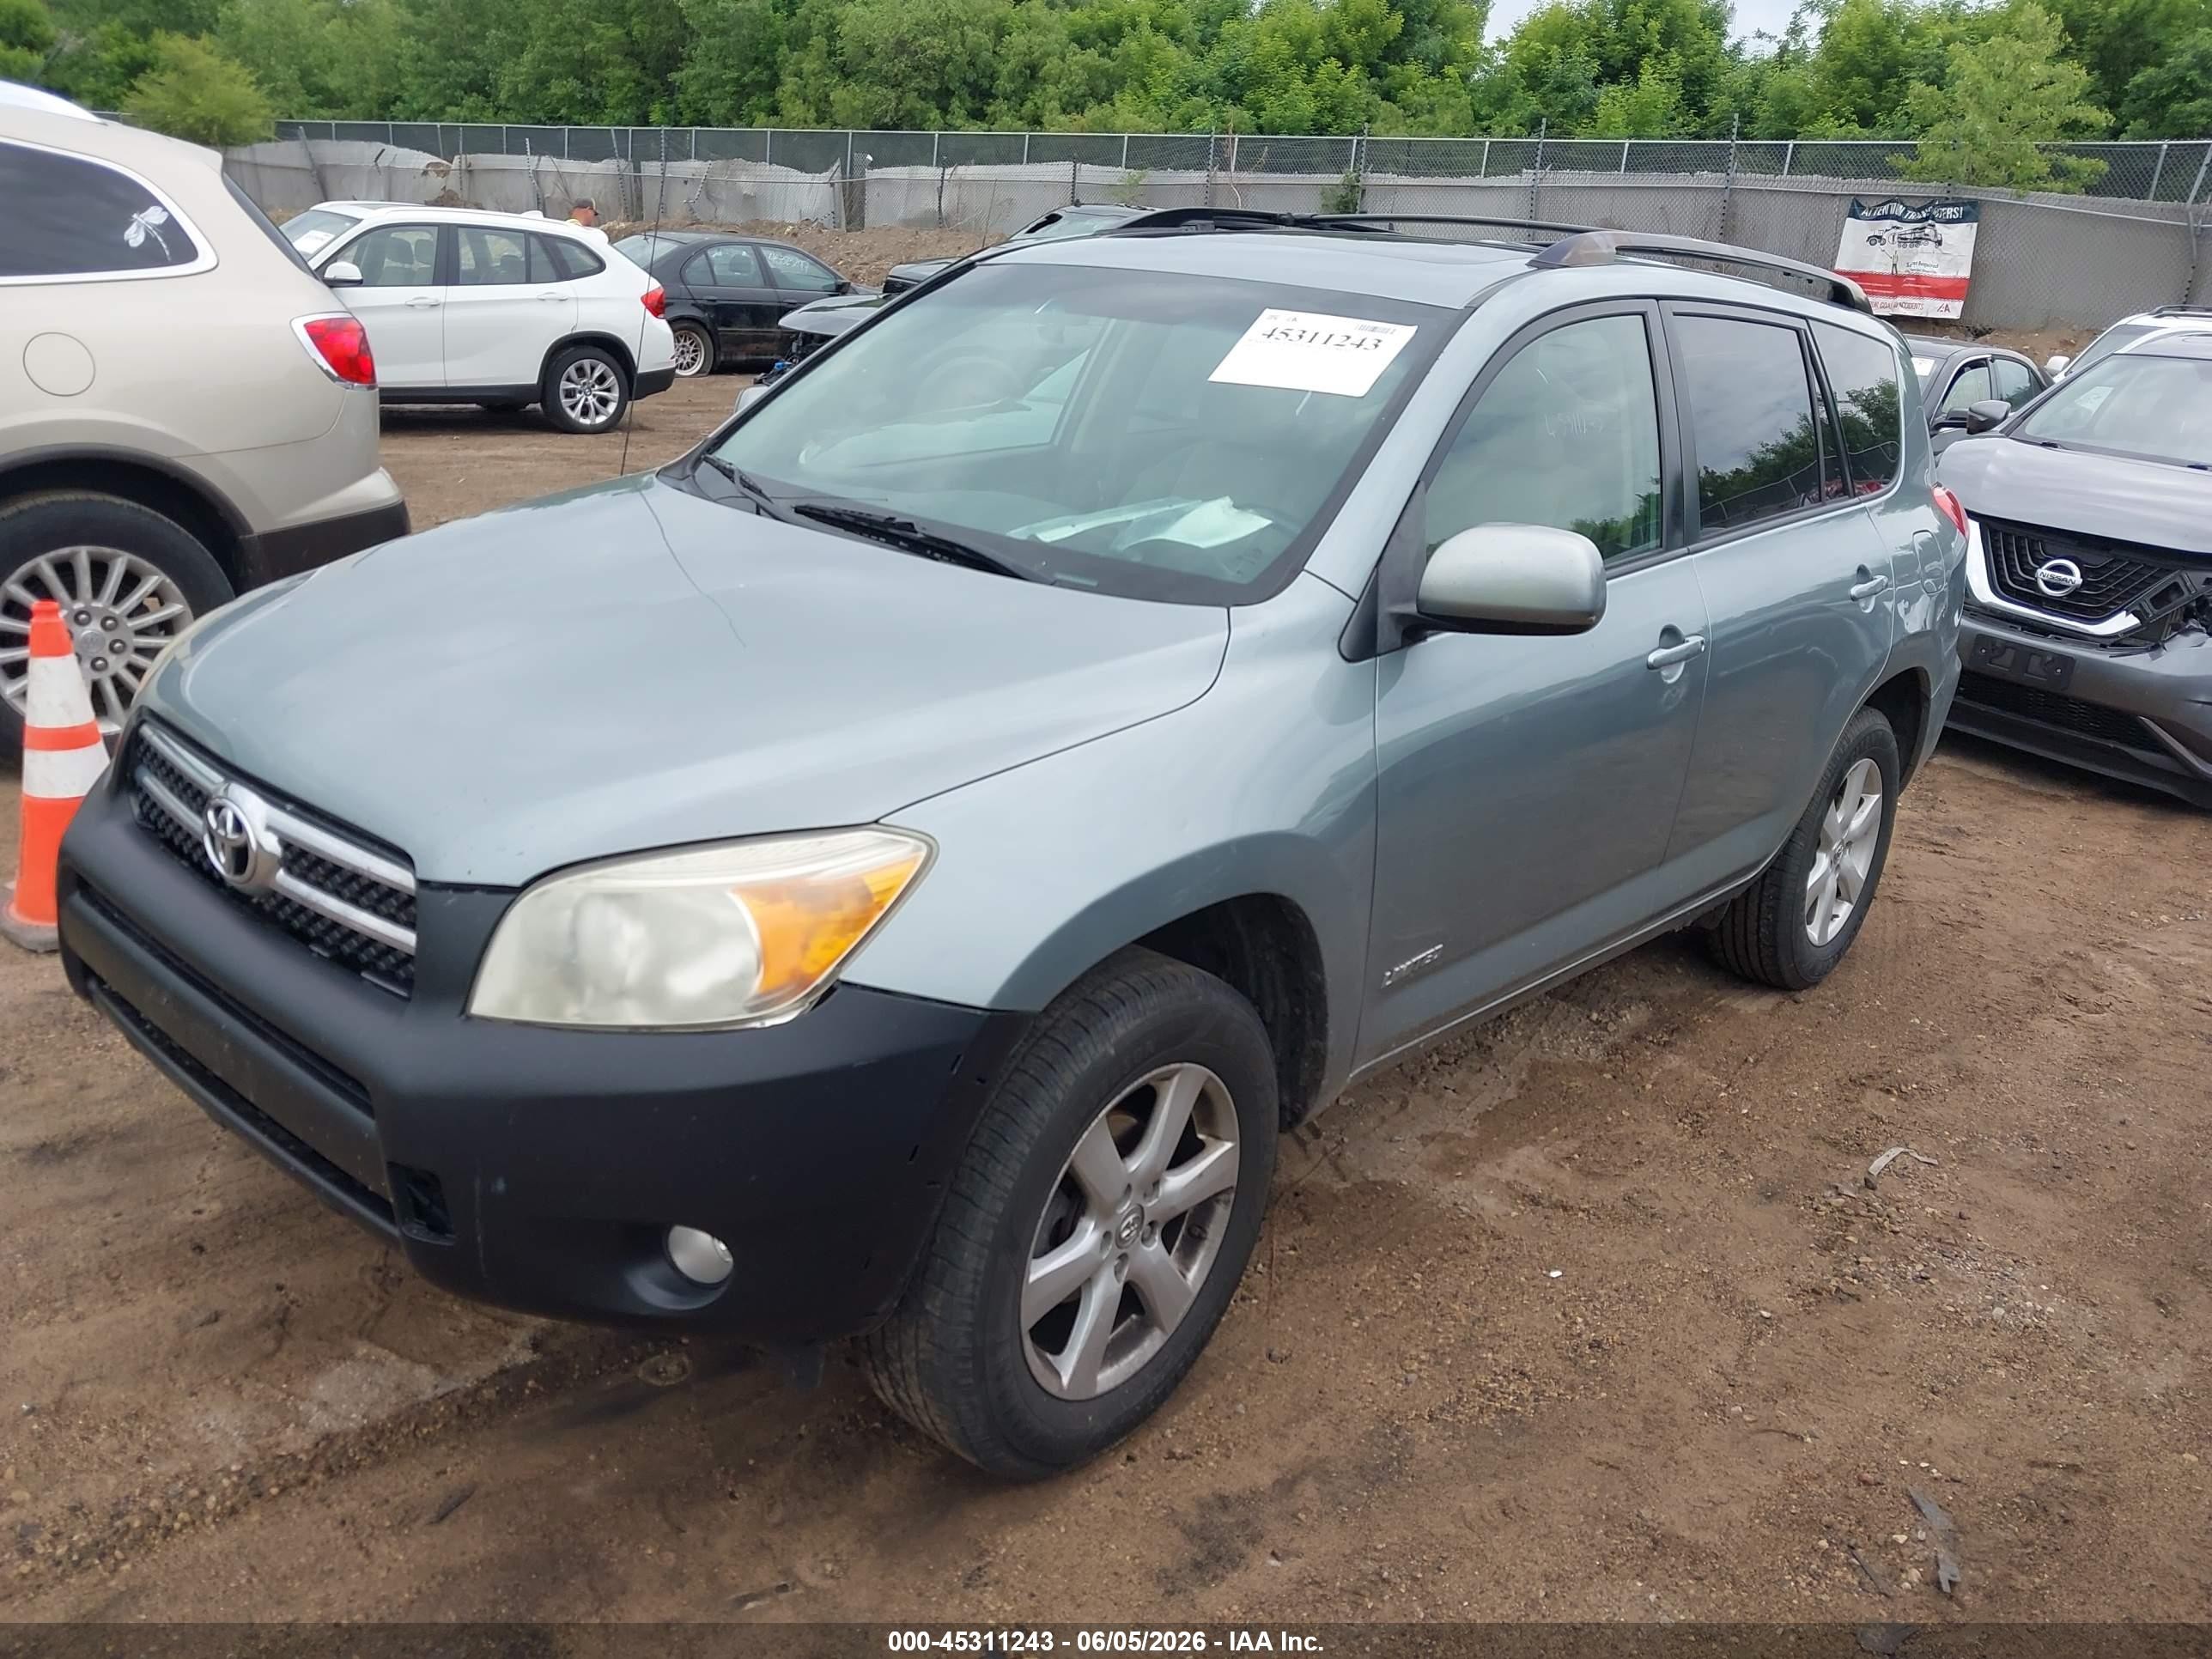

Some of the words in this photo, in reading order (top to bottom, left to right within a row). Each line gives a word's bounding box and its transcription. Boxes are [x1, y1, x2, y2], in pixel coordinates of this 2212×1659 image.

[1862, 203, 1905, 217] ATTENTION
[1262, 326, 1382, 351] 45311243
[2039, 571, 2076, 585] NISSAN
